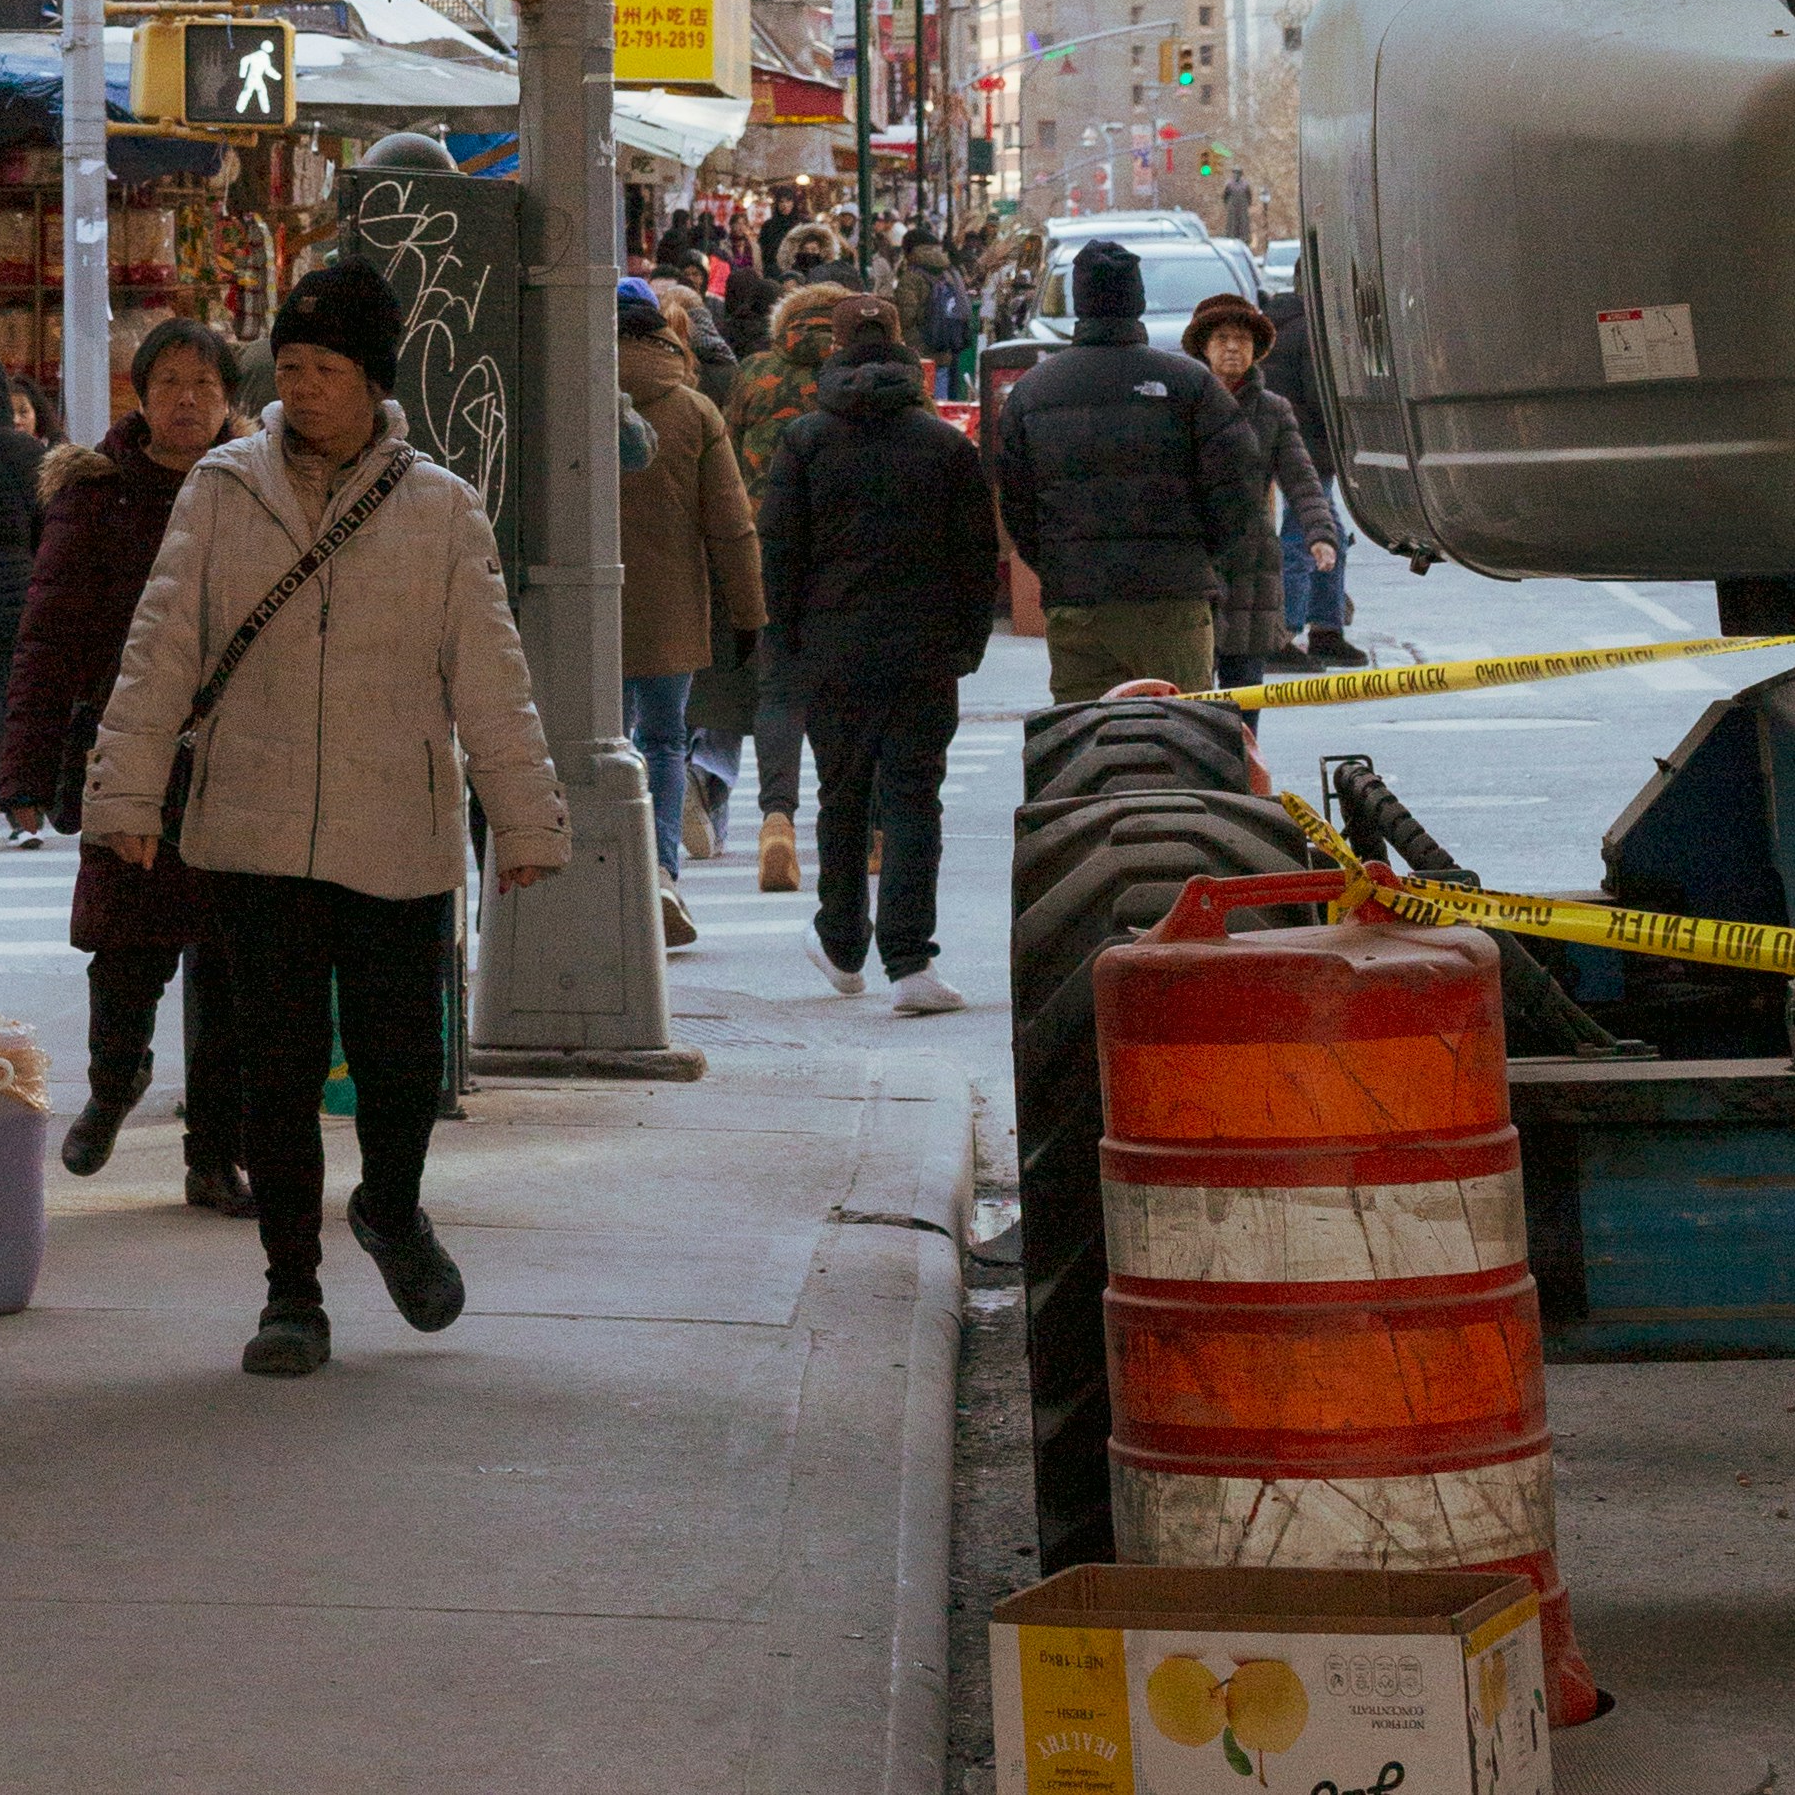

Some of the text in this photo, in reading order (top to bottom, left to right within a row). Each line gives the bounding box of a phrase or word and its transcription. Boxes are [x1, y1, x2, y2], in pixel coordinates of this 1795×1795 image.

[613, 7, 708, 27] 州小吃店
[613, 30, 706, 49] 12-791-2819
[1039, 1650, 1106, 1670] NET:18kg
[1056, 1707, 1094, 1720] FRESH
[1349, 1704, 1425, 1717] CONCENTRATE
[1371, 1718, 1425, 1730] NOT FROM
[1035, 1730, 1118, 1763] HEALTHY
